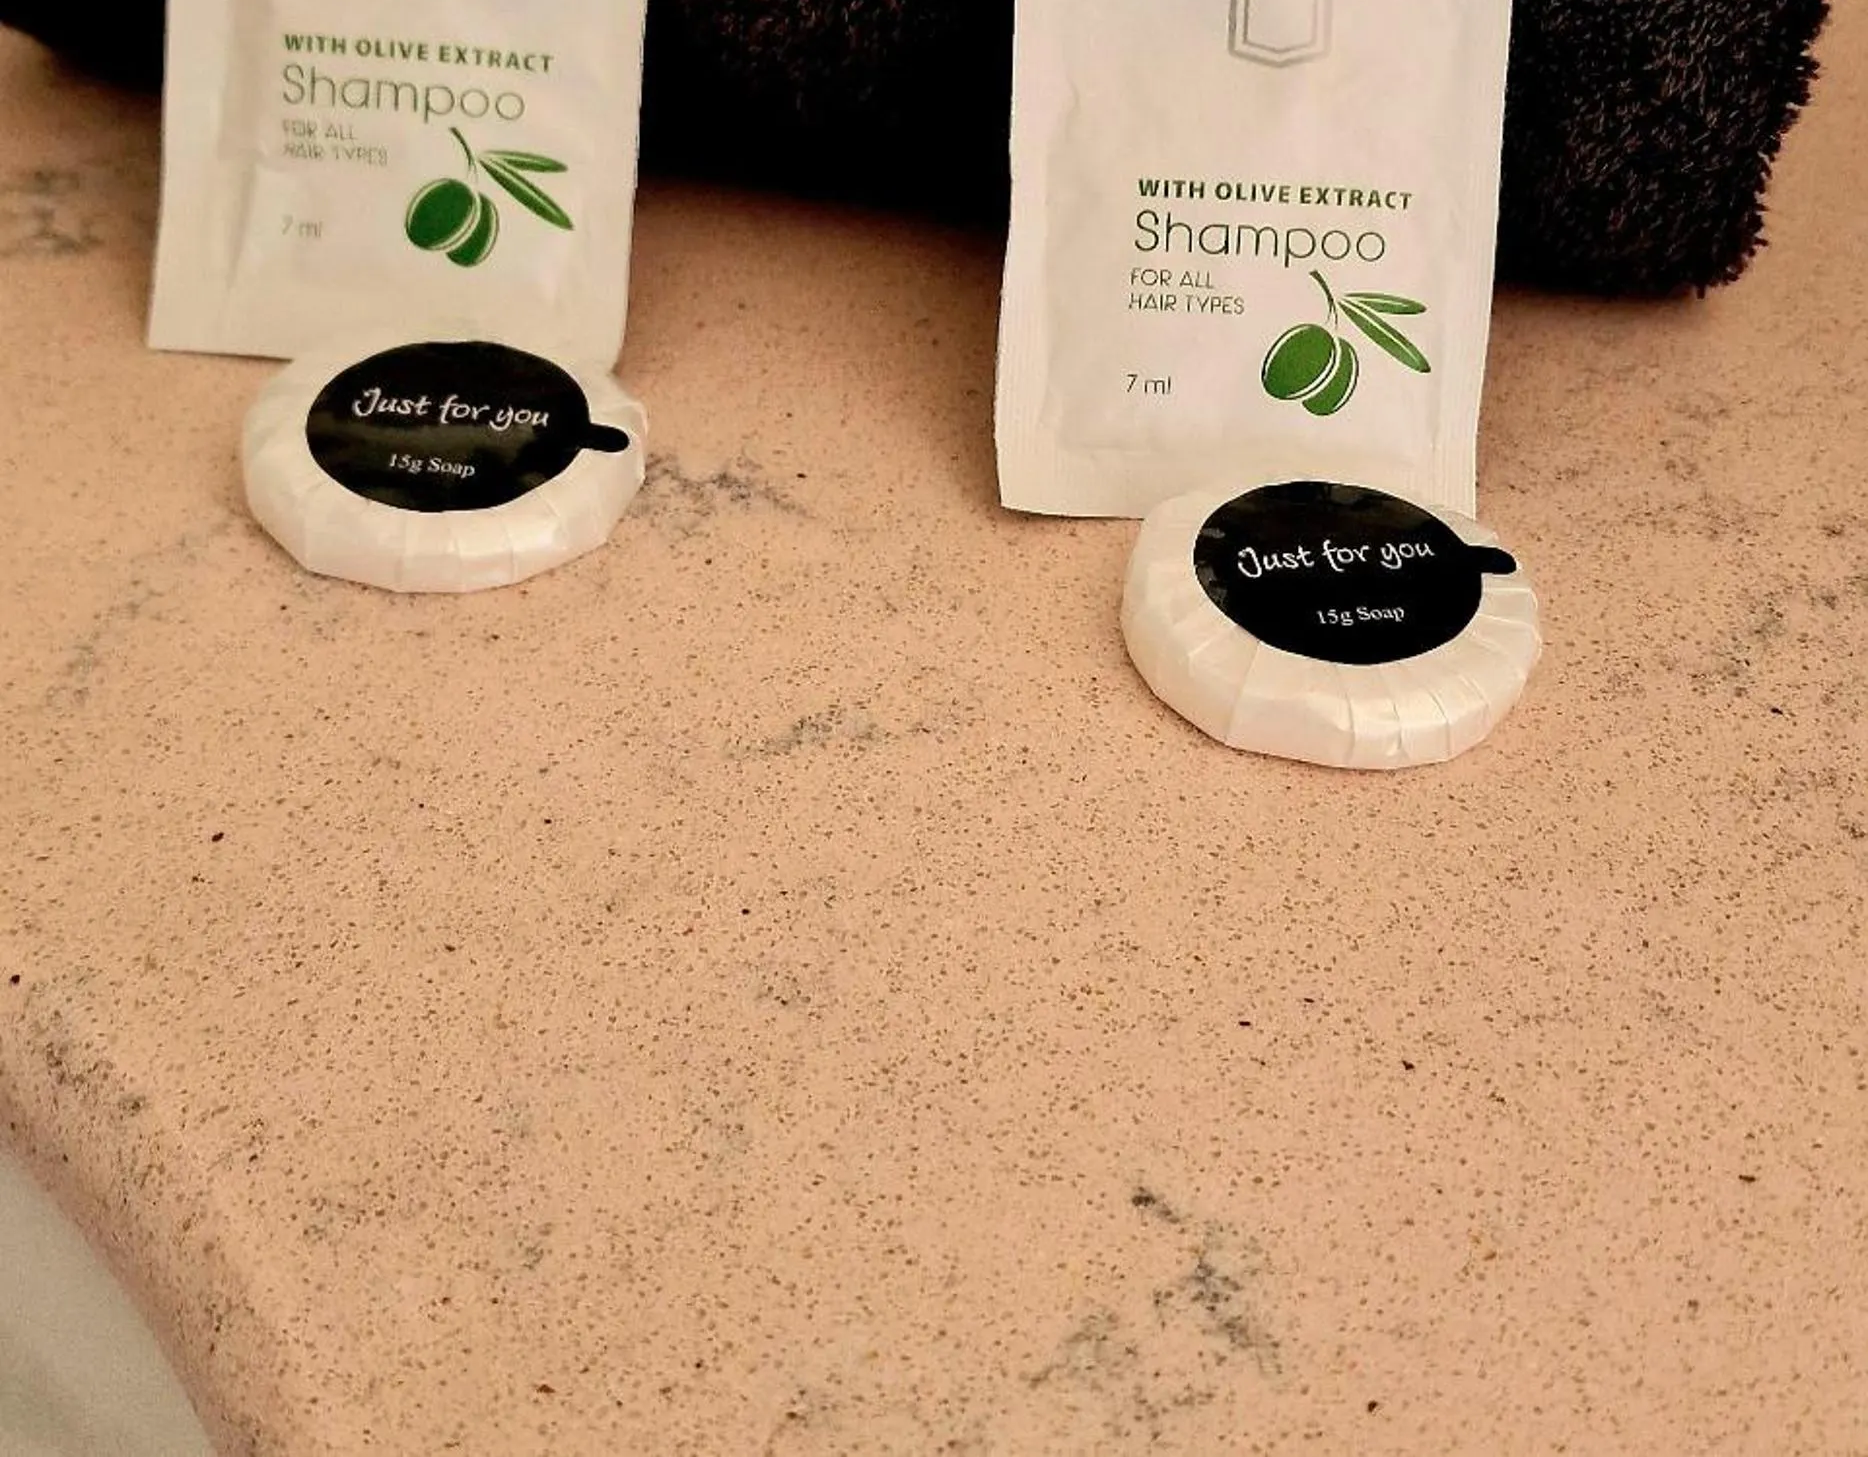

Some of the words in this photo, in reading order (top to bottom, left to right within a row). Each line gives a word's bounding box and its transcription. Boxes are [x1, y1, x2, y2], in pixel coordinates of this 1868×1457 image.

[284, 33, 346, 55] WITH
[355, 38, 429, 61] OLIVE
[438, 45, 554, 73] EXTRACT
[282, 63, 525, 123] Shampoo
[282, 119, 320, 140] FOR
[325, 123, 358, 141] ALL
[283, 143, 325, 161] HAIR
[334, 147, 388, 166] TYPES
[1138, 179, 1205, 199] WITH
[1215, 182, 1290, 204] OLIVE
[1300, 186, 1412, 210] EXTRACT
[1134, 209, 1386, 268] Shampoo
[1130, 267, 1172, 288] FOR
[1179, 270, 1214, 289] ALL
[1128, 293, 1178, 312] HAIR
[1184, 295, 1245, 315] TYPES
[1125, 374, 1138, 394] 7
[1144, 376, 1172, 395] ml
[353, 386, 431, 417] Just
[438, 393, 491, 424] for
[489, 404, 549, 431] you
[388, 453, 422, 474] 15g
[427, 457, 476, 478] Soap
[1237, 546, 1315, 578] Just
[1321, 539, 1370, 573] for
[1380, 540, 1435, 569] you
[1316, 608, 1354, 626] 15g
[1357, 606, 1405, 623] Soap
